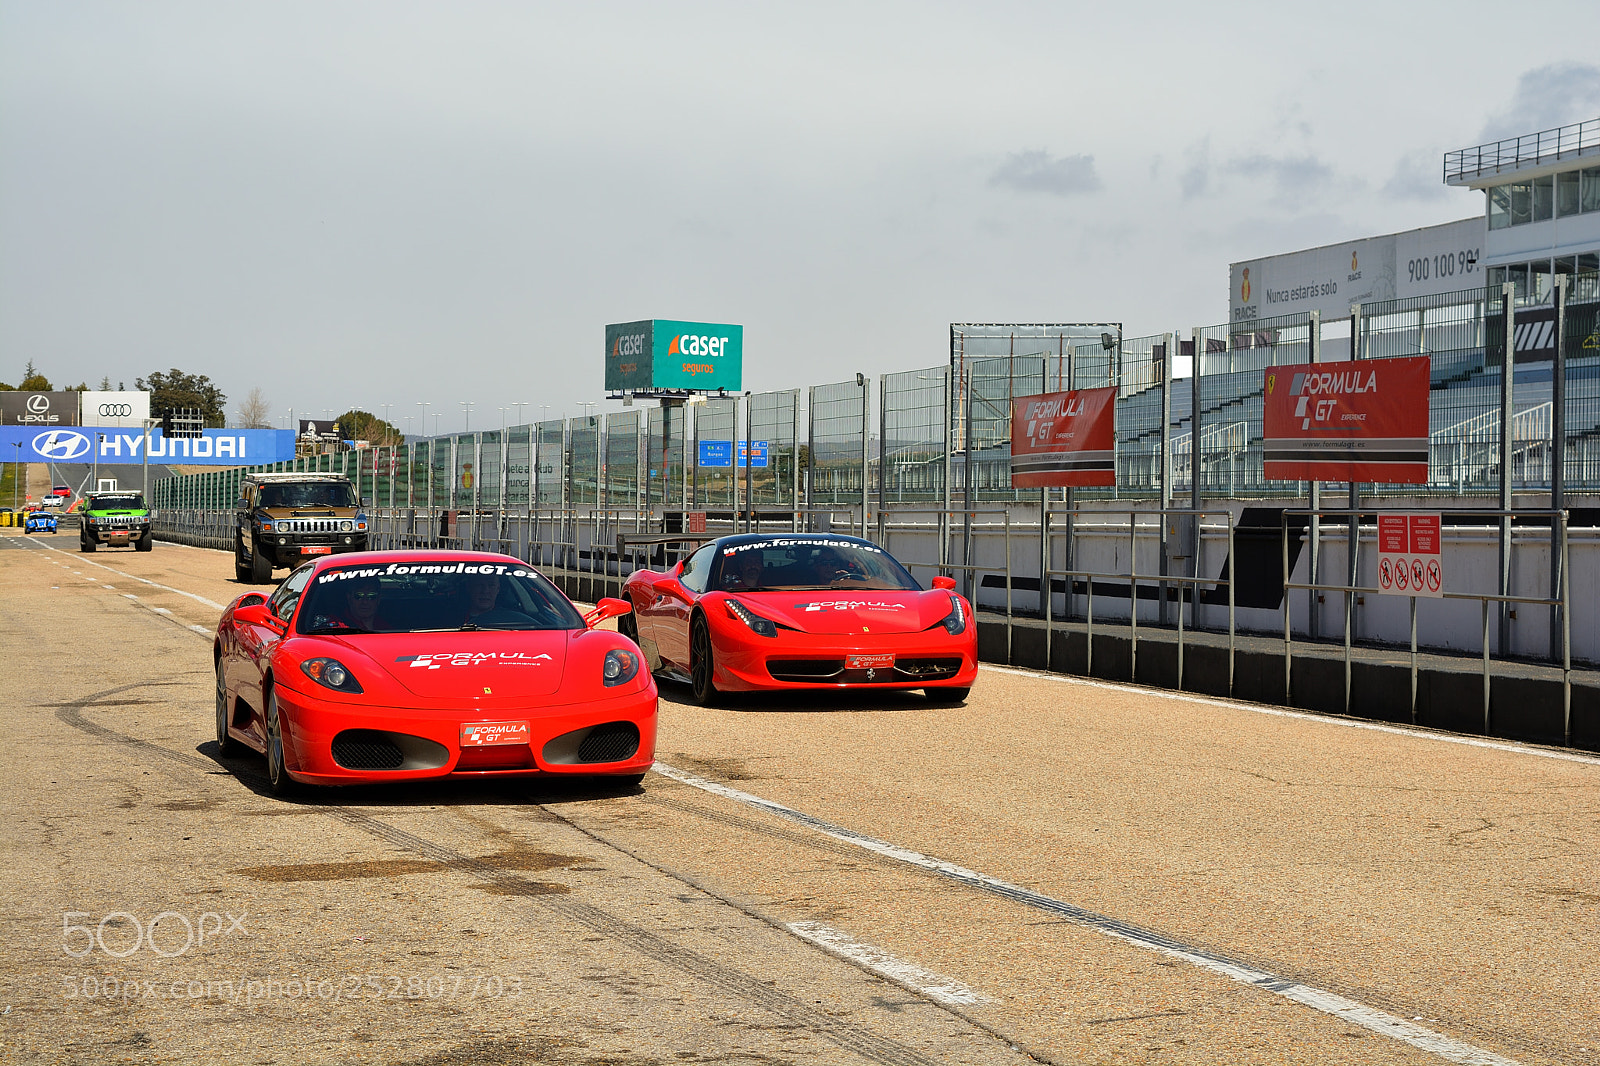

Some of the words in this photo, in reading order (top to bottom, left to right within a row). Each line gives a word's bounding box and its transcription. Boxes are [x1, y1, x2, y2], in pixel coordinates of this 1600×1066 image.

[1408, 258, 1430, 282] 900
[1434, 252, 1455, 279] 100
[1458, 248, 1480, 274] 901
[1348, 271, 1362, 282] RACE
[1266, 288, 1289, 304] Nunca
[1290, 281, 1319, 301] estarás
[1320, 279, 1338, 296] solo
[1235, 305, 1257, 321] RACE
[619, 333, 645, 356] caser
[680, 334, 729, 357] caser
[682, 362, 714, 377] seguros
[1301, 370, 1377, 395] FORMULA
[1032, 398, 1085, 420] FORMULA
[1315, 399, 1337, 421] GT
[1341, 413, 1367, 421] EXPERIENCE
[17, 414, 59, 423] LEXUS
[1039, 421, 1054, 440] GT
[100, 434, 246, 458] HYUNDAI
[723, 538, 882, 555] www.formulaGT.es
[318, 562, 538, 584] www.formulaGT.es
[808, 600, 906, 609] FORMULA
[416, 652, 553, 661] FORMULA
[450, 658, 487, 666] GT
[474, 724, 527, 734] FORMULA
[486, 733, 501, 742] GT
